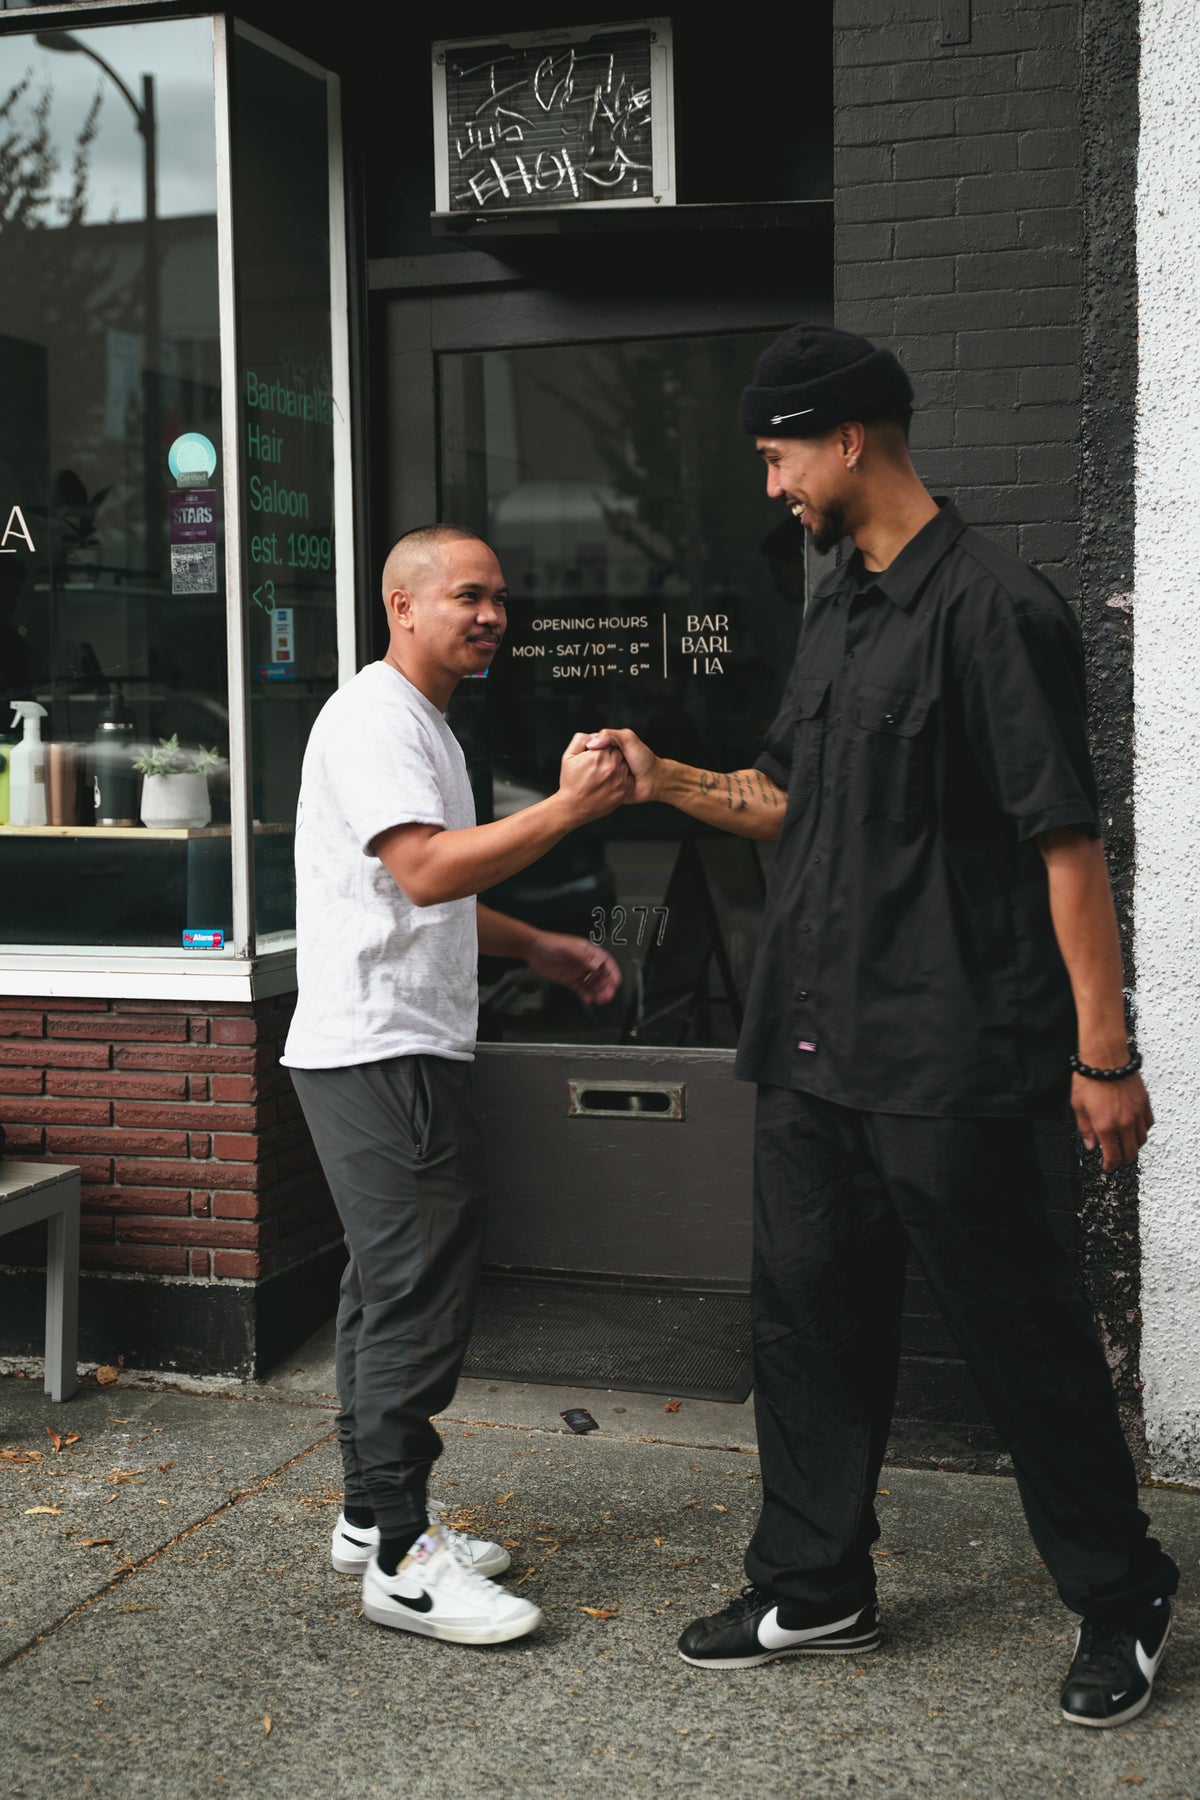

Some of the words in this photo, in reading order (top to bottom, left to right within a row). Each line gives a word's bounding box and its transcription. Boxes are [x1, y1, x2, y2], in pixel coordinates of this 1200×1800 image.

[247, 370, 332, 425] Barbarella
[248, 423, 285, 464] Hair
[173, 507, 213, 524] STARS
[250, 475, 309, 519] Saloon
[251, 532, 283, 565] est.
[288, 532, 331, 570] 1999
[532, 618, 595, 631] OPENING
[599, 616, 648, 629] HOURS
[687, 614, 729, 632] BAR
[512, 646, 545, 657] MON
[589, 905, 669, 946] 3277
